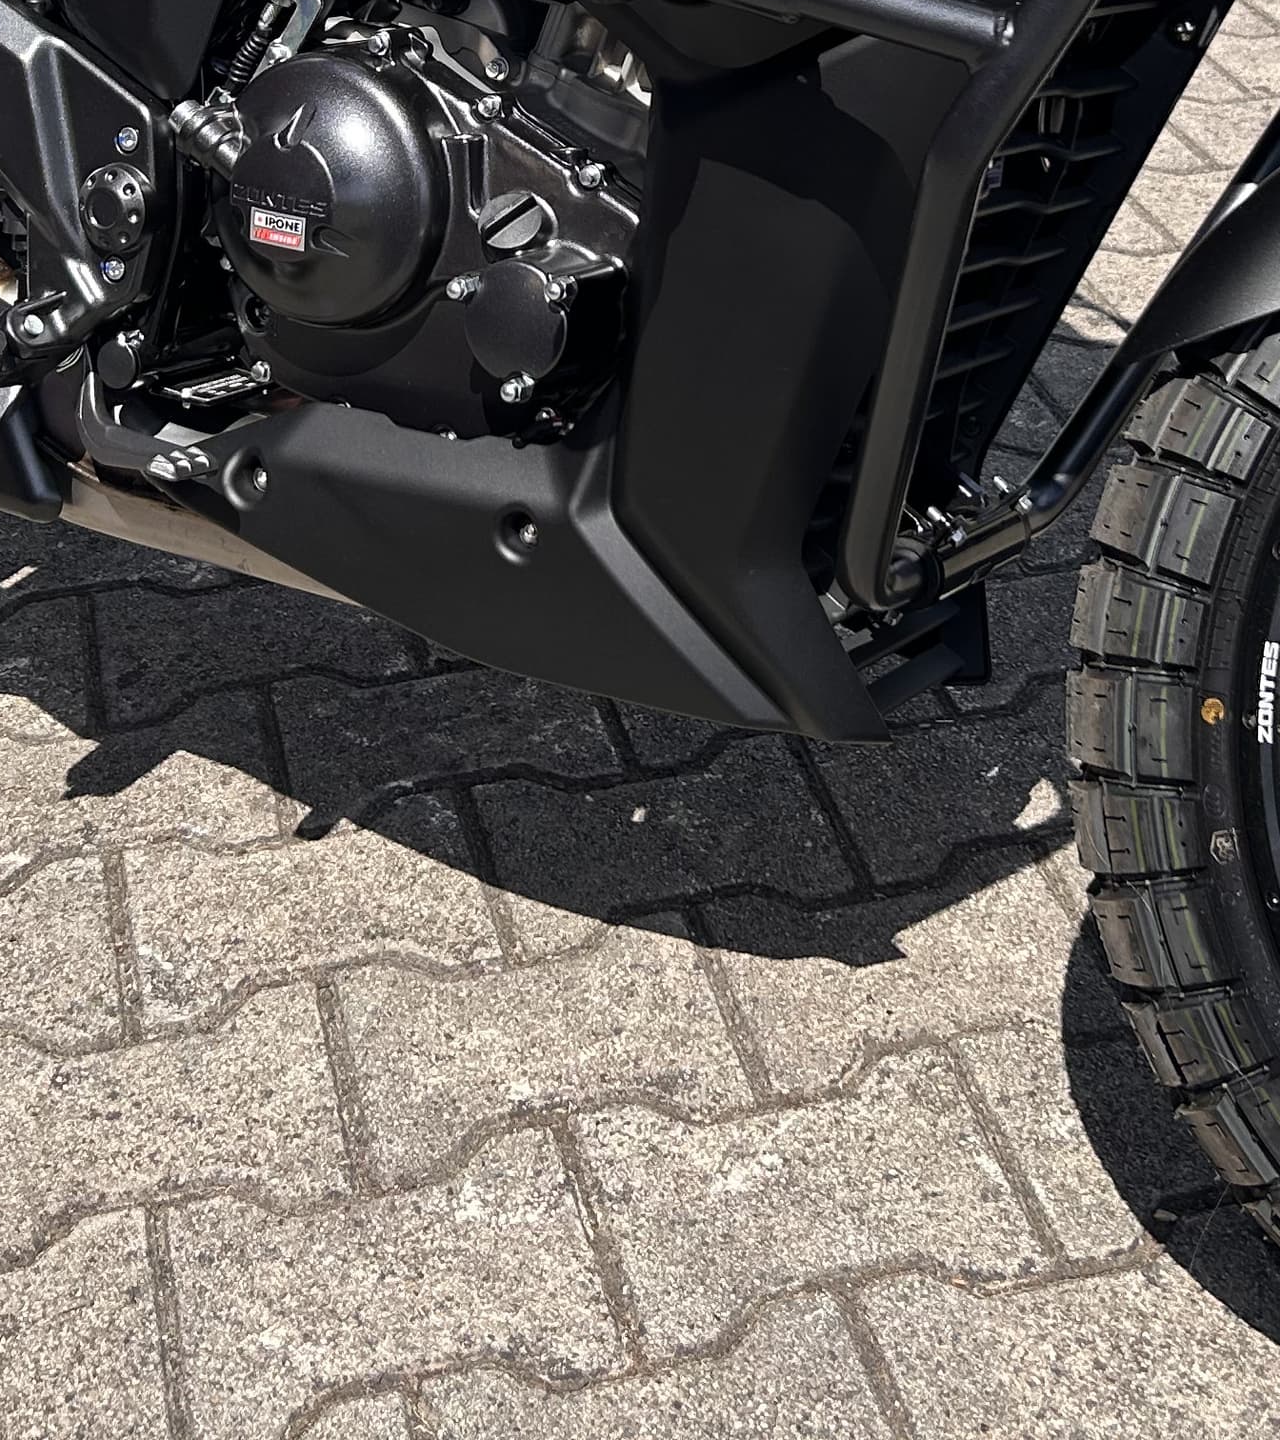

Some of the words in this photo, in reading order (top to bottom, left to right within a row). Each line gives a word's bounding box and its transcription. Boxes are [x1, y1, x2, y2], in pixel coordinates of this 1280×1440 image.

[232, 183, 328, 218] ZONTES
[265, 216, 301, 233] IPONE
[1257, 639, 1280, 745] ZONTES
